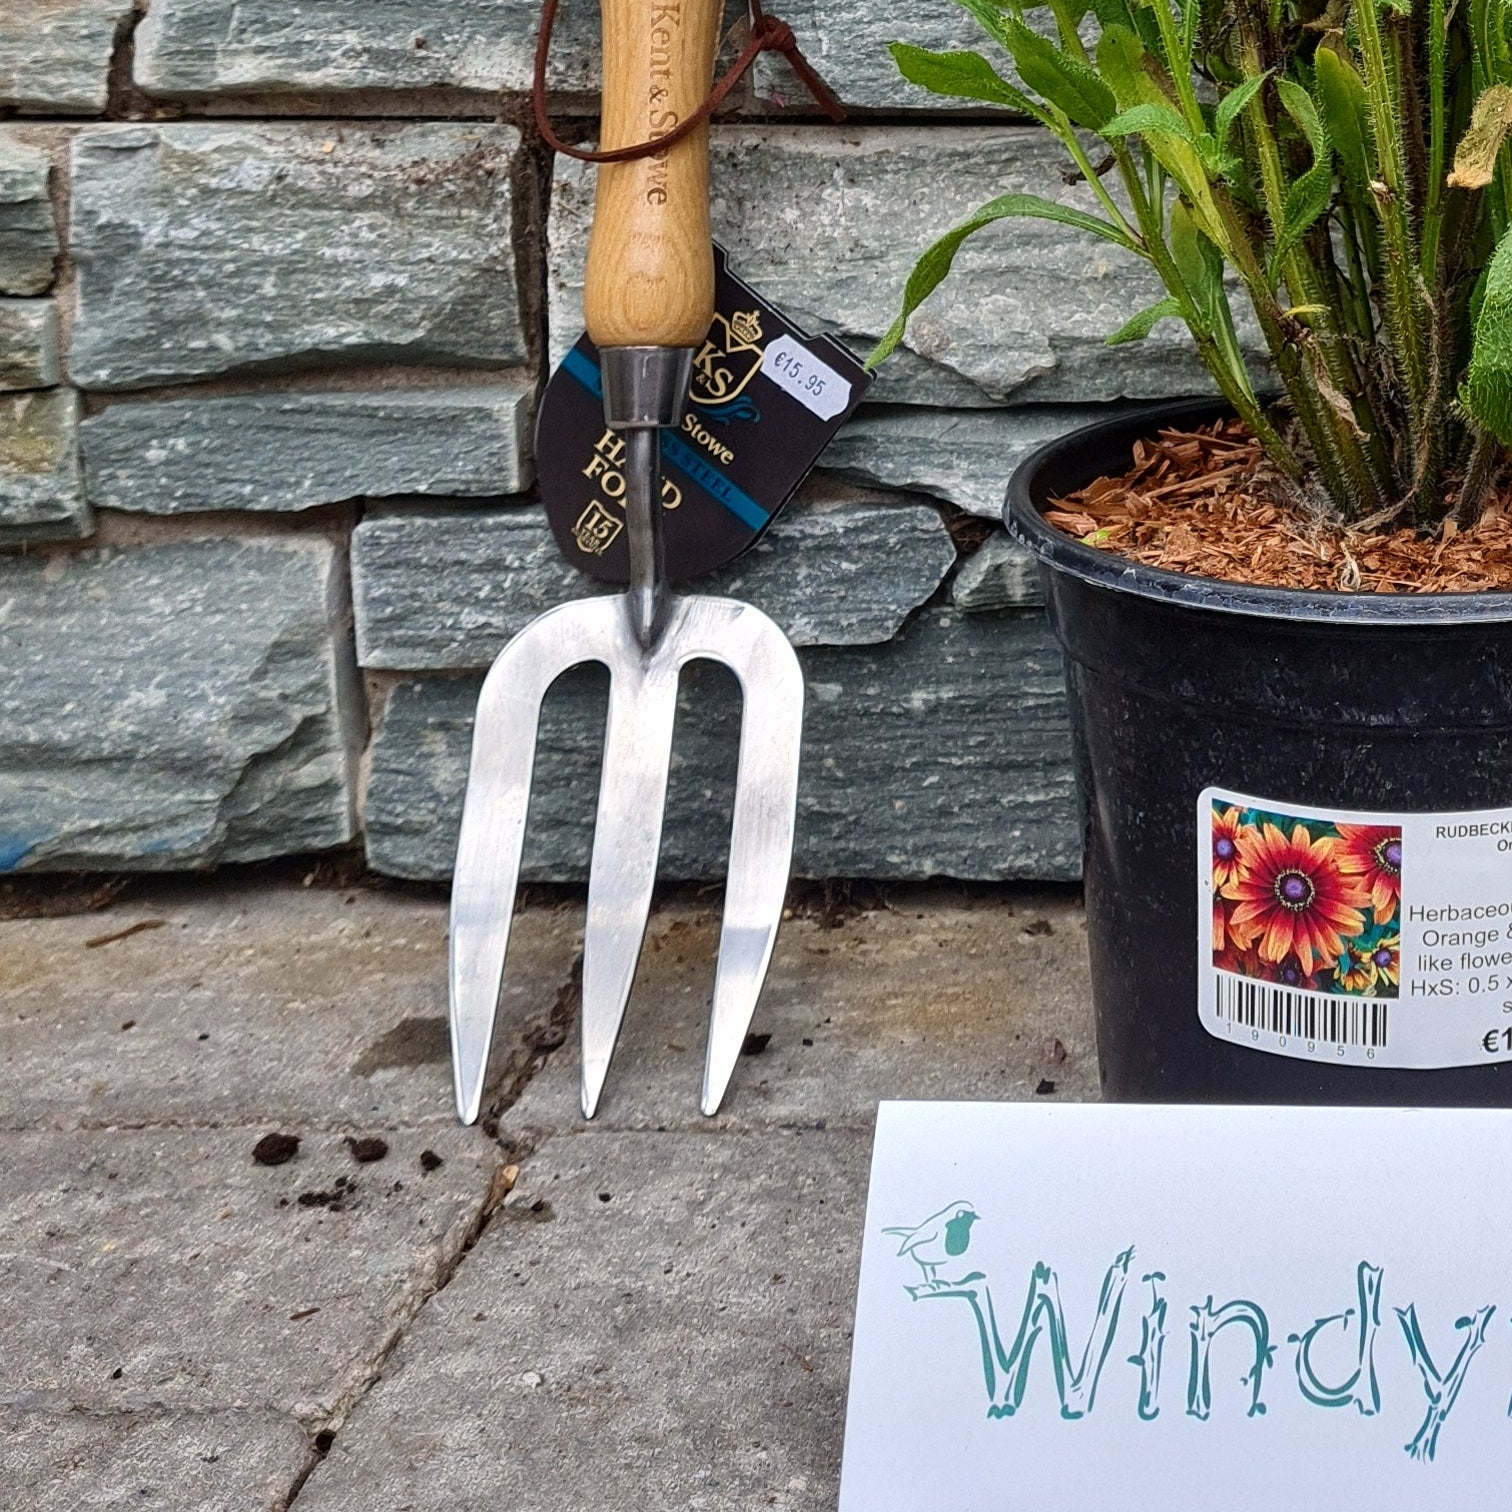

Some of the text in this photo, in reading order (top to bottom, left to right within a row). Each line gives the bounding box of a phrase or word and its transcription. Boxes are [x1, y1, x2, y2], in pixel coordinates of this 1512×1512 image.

[650, 1, 681, 80] Kent
[649, 87, 669, 104] &
[774, 351, 827, 397] €15.95
[681, 413, 735, 465] Stowe
[594, 428, 683, 510] HD
[584, 510, 613, 539] 15
[1422, 928, 1499, 948] Orange
[1418, 955, 1453, 972] like
[1411, 979, 1460, 996] HxS:
[1468, 974, 1499, 994] 0.5
